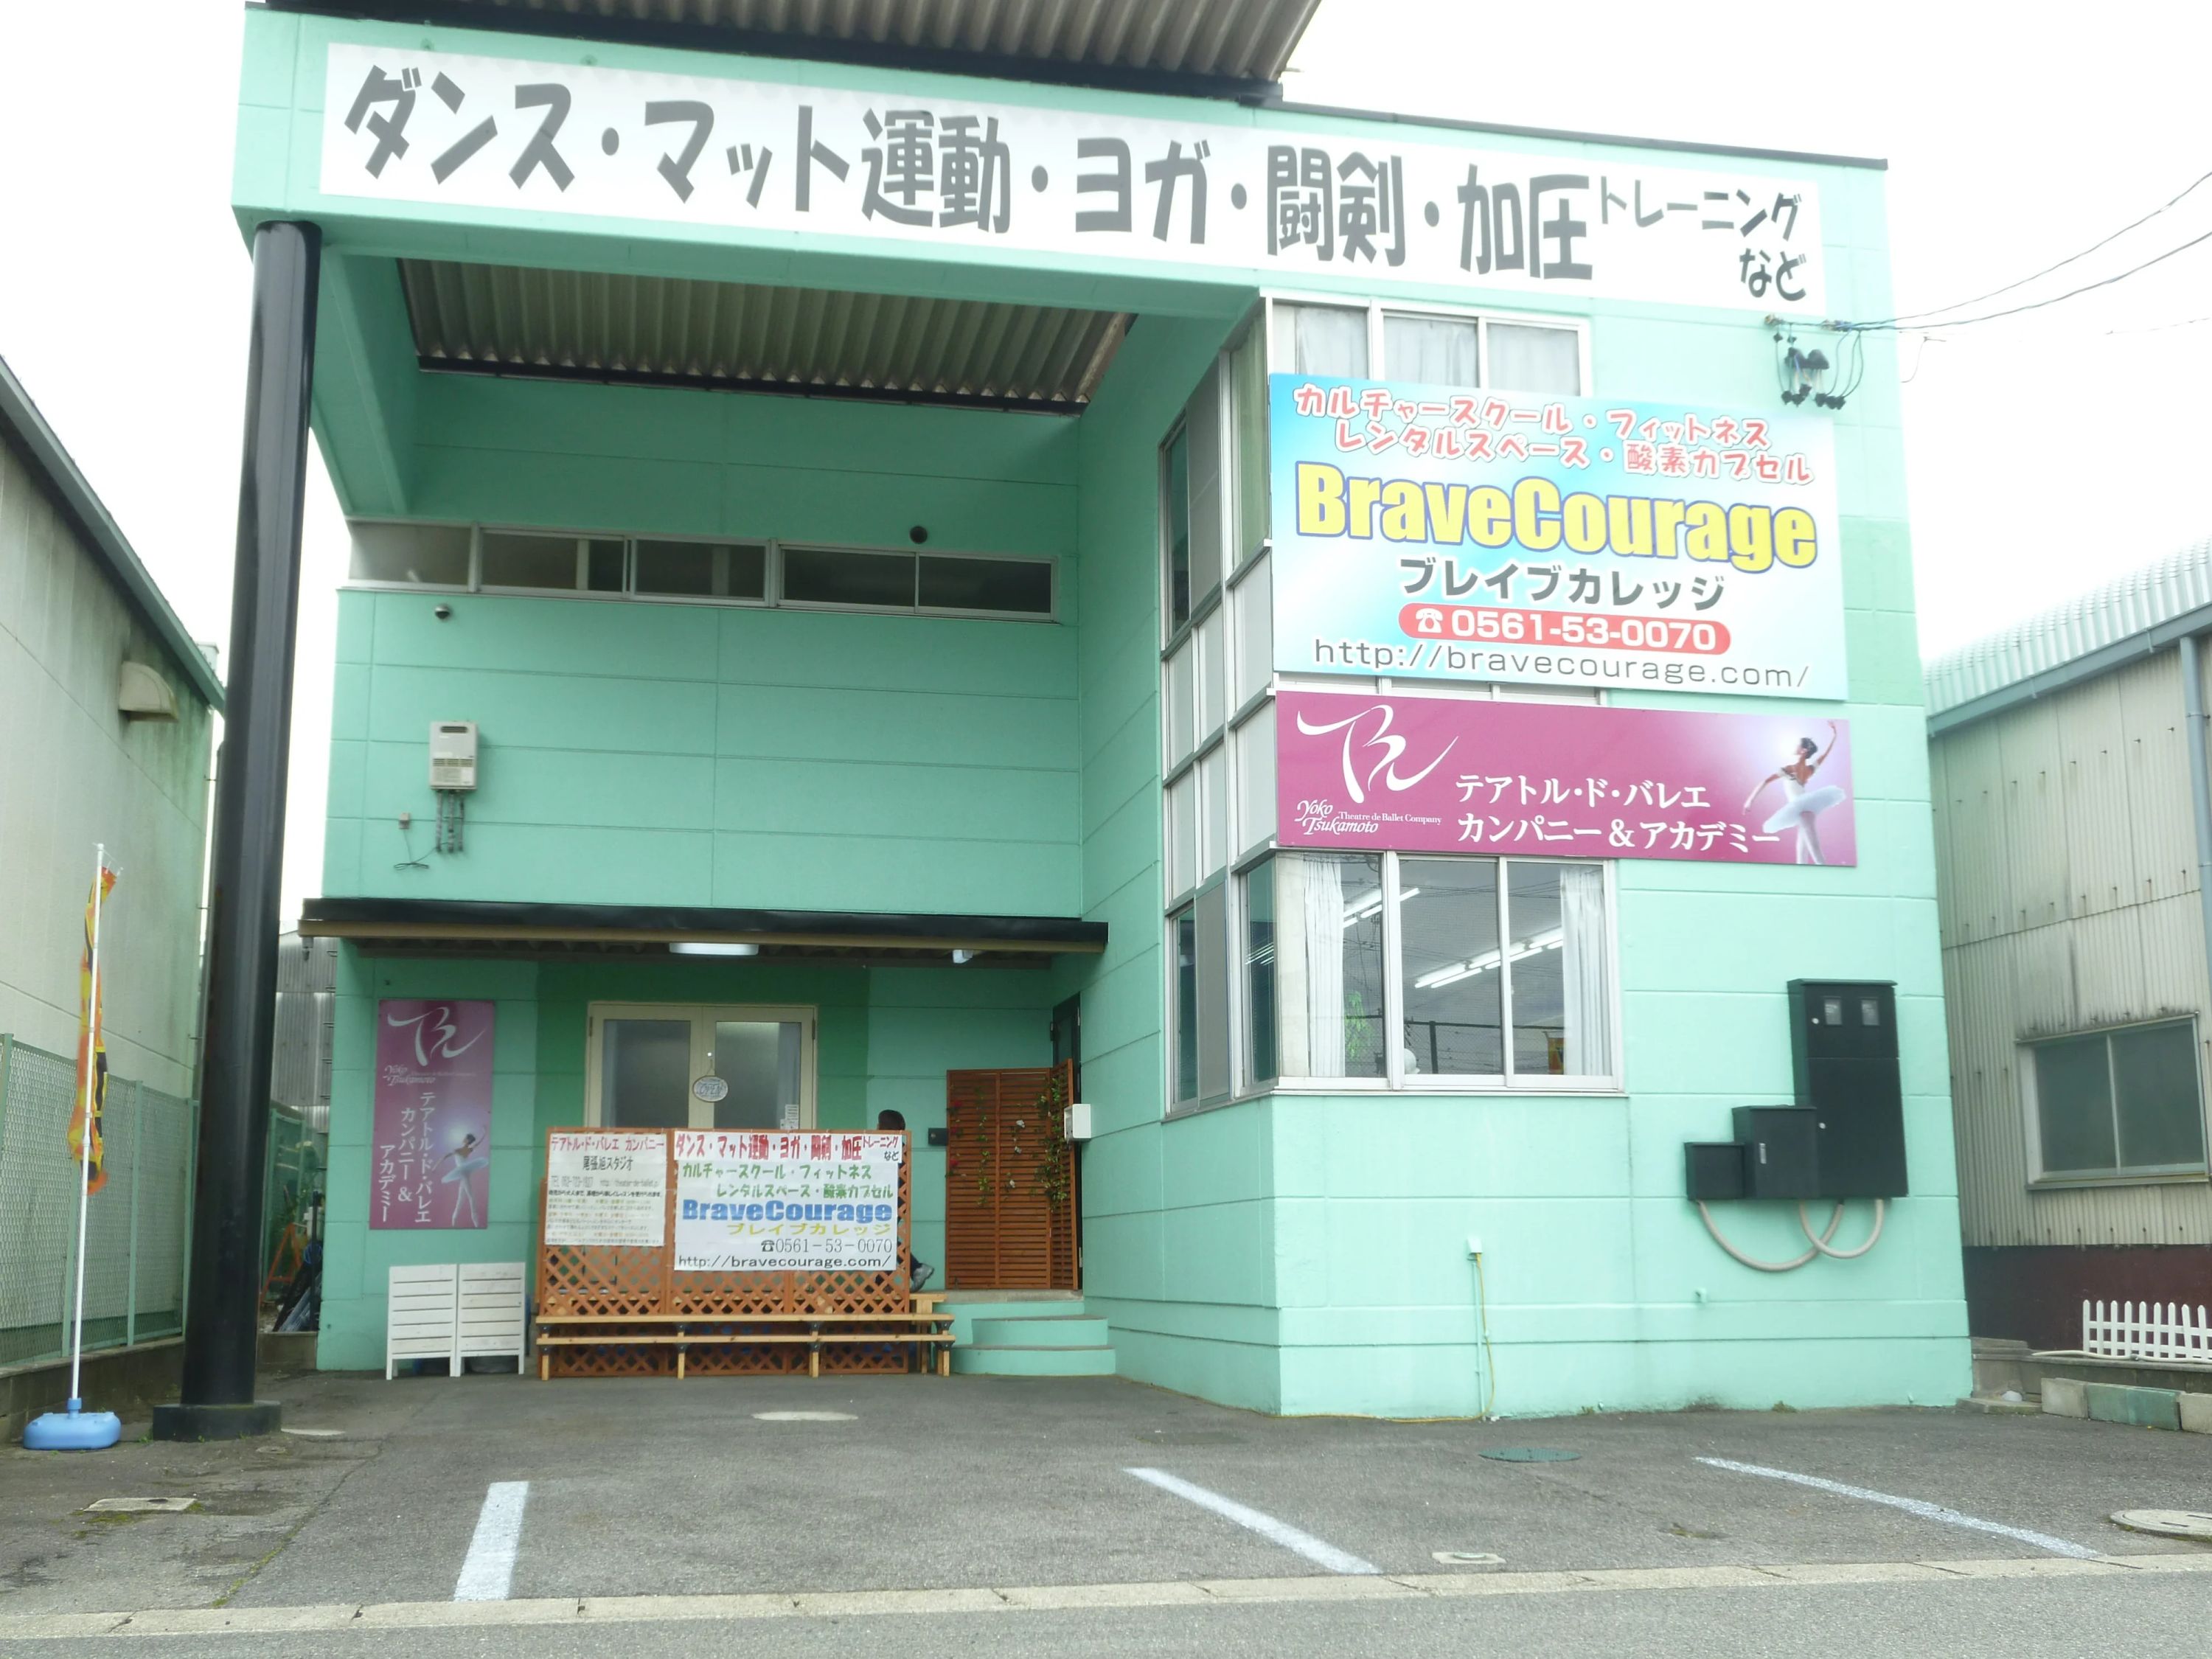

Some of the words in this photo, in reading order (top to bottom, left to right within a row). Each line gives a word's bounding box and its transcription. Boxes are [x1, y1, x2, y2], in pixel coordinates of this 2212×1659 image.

[1739, 248, 1806, 301] など
[1295, 386, 1769, 446] カルチャースクール・フィットネス
[1336, 417, 1814, 483] レンタルスペース・酸素カプセル
[1295, 460, 1818, 573] BraveCourage
[1400, 557, 1724, 610] ブレイブカレッジ
[1452, 610, 1717, 650] 0561-53-0070
[1315, 639, 1808, 687] http://bravecourage.com/
[1455, 774, 1711, 808] テアトル・ド・バレエ
[1295, 799, 1333, 821] Yoko
[1302, 816, 1379, 835] Tsukamoto
[1338, 812, 1370, 820] Theatre
[1382, 813, 1403, 821] Ballet
[1405, 814, 1441, 825] Company
[414, 1092, 436, 1222] テアトル・ド・バレエ
[683, 1163, 872, 1179] カルチャースクール・フィットネス
[378, 1145, 396, 1222] アカデミー
[717, 1183, 894, 1199] レンタルスペース・酸素カプセル
[683, 1199, 892, 1223] BraveCourage
[727, 1222, 891, 1235] ブレイブカレッジ
[679, 1256, 891, 1268] http://bravecourage.com/
